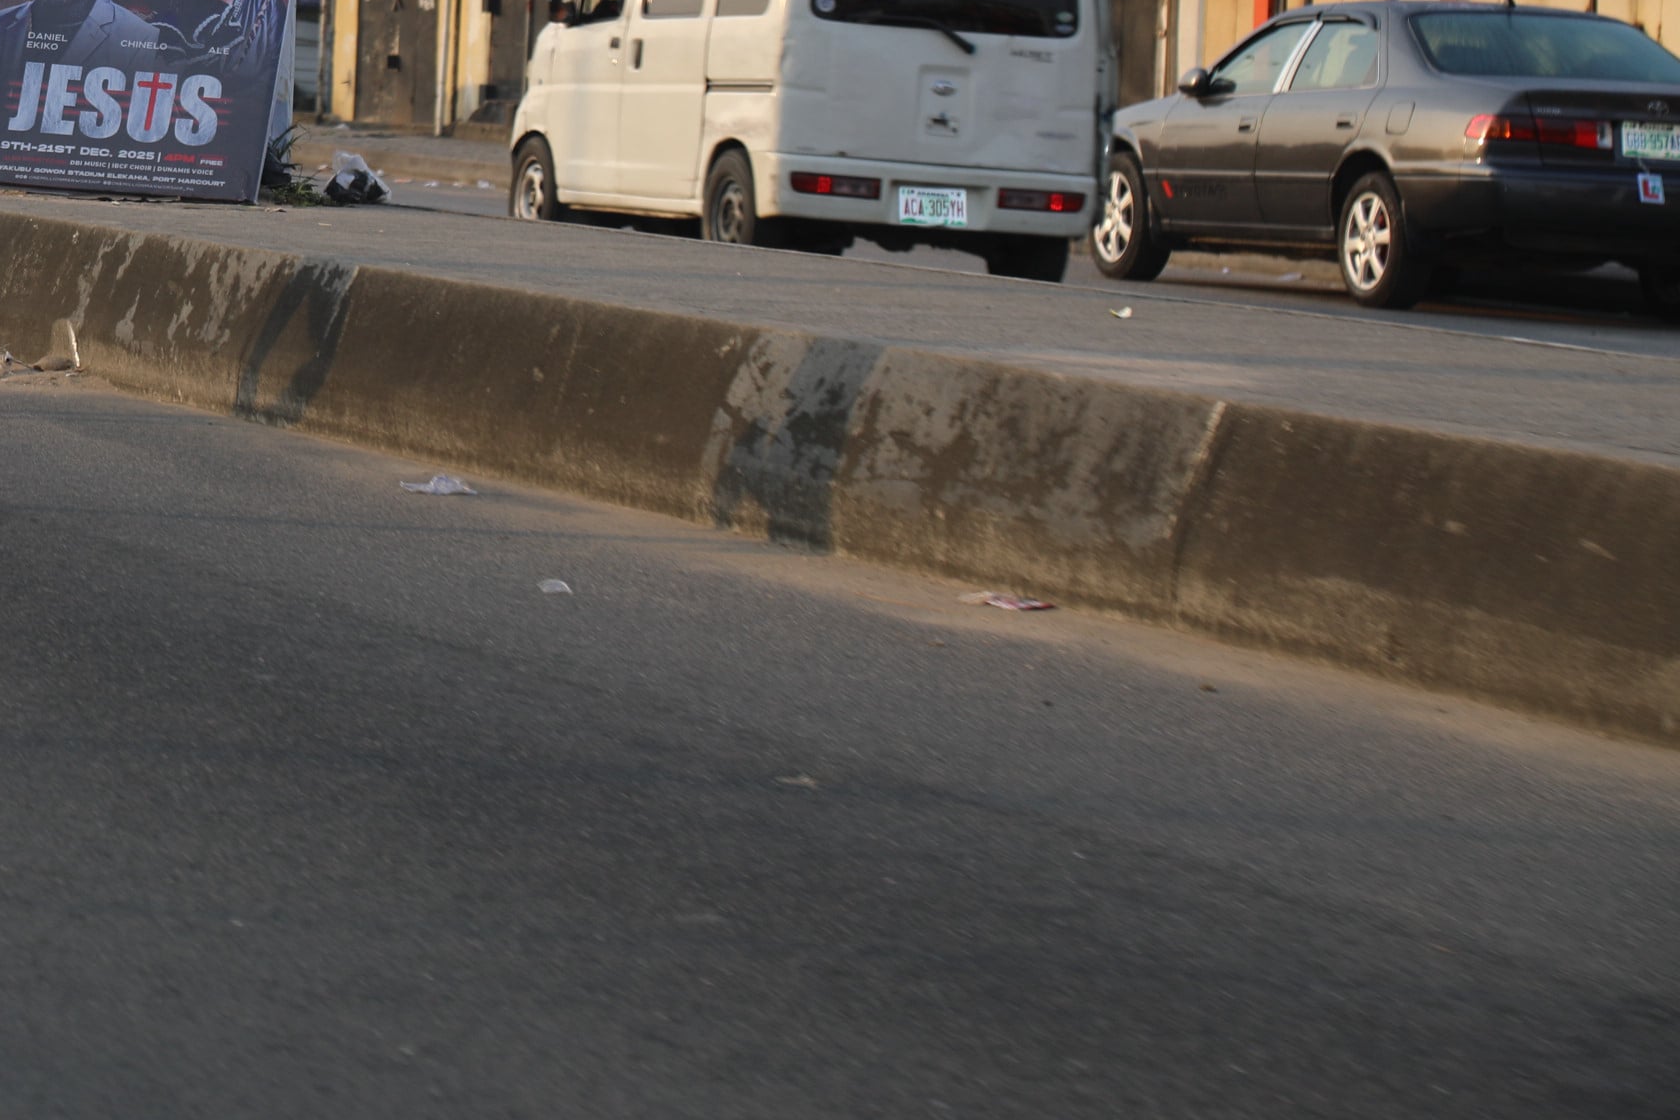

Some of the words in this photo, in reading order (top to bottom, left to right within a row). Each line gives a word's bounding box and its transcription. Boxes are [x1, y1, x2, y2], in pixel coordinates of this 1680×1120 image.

[27, 31, 68, 43] DANIEL
[26, 40, 58, 51] EKIKO
[120, 39, 168, 50] CHINELO
[208, 45, 230, 55] ALE
[8, 61, 223, 147] JESUS
[80, 146, 113, 157] DEC.
[118, 149, 155, 160] 2025
[129, 162, 152, 171] CHOIR
[157, 166, 190, 174] DUNAMIS
[192, 168, 214, 176] VOICE
[33, 167, 65, 175] GOWON
[67, 169, 105, 178] STADIUM
[177, 178, 226, 187] HARCOURT
[1642, 178, 1660, 199] L
